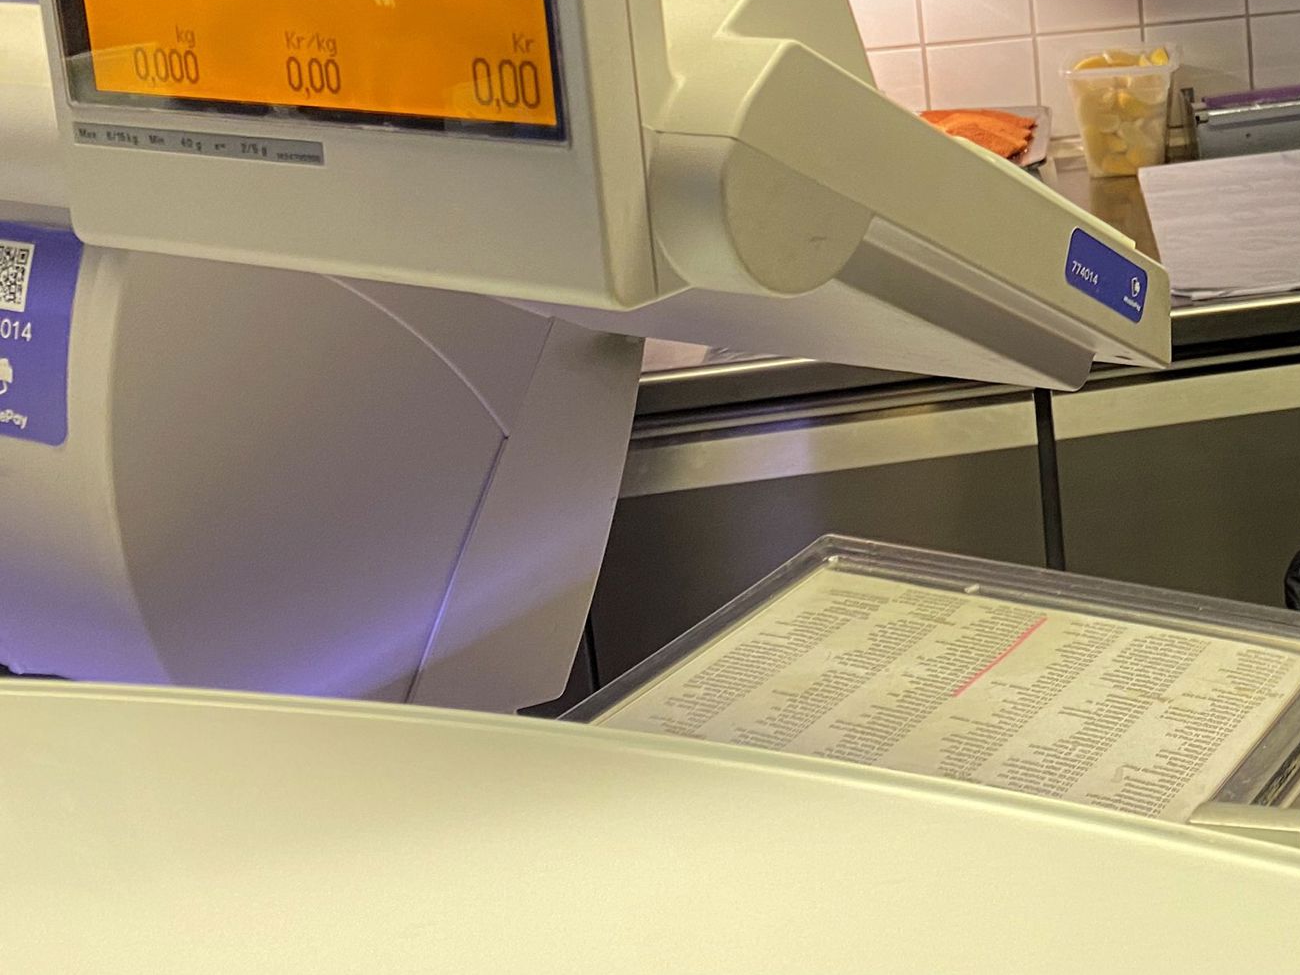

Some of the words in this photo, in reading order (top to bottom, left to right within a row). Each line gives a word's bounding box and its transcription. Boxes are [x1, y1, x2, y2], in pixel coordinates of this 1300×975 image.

[175, 26, 196, 48] kg
[284, 31, 338, 57] Kr/kg
[512, 33, 535, 53] Kr
[133, 47, 200, 86] 0,000
[285, 55, 341, 100] 0,00
[472, 57, 541, 114] 0,00
[1071, 260, 1099, 285] 774014
